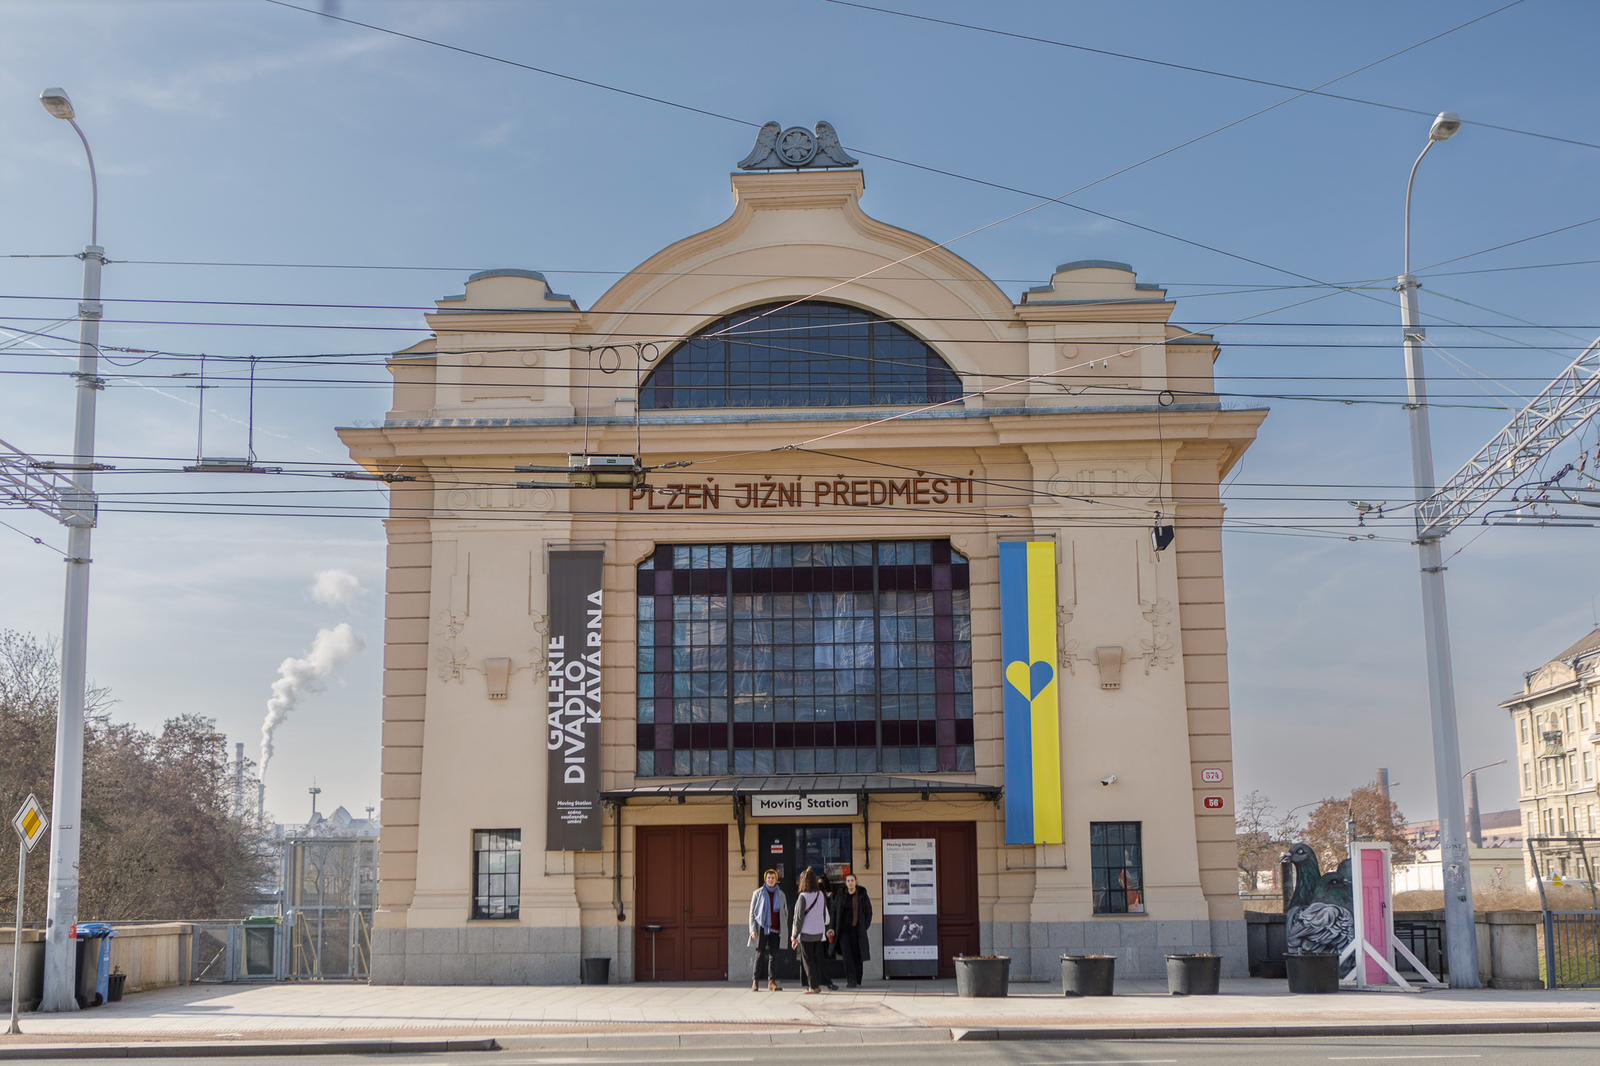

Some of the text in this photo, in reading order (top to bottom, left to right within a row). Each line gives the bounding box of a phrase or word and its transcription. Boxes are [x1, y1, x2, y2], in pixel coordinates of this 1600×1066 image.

[629, 470, 975, 510] PLZEŇ JIŽNÍ PŘEDMĚSTÍ
[548, 635, 565, 751] GALERIE
[581, 589, 603, 724] KAVÁRNA
[564, 660, 586, 784] DIVADLO
[760, 798, 849, 811] Moving Station
[1208, 798, 1219, 807] 56
